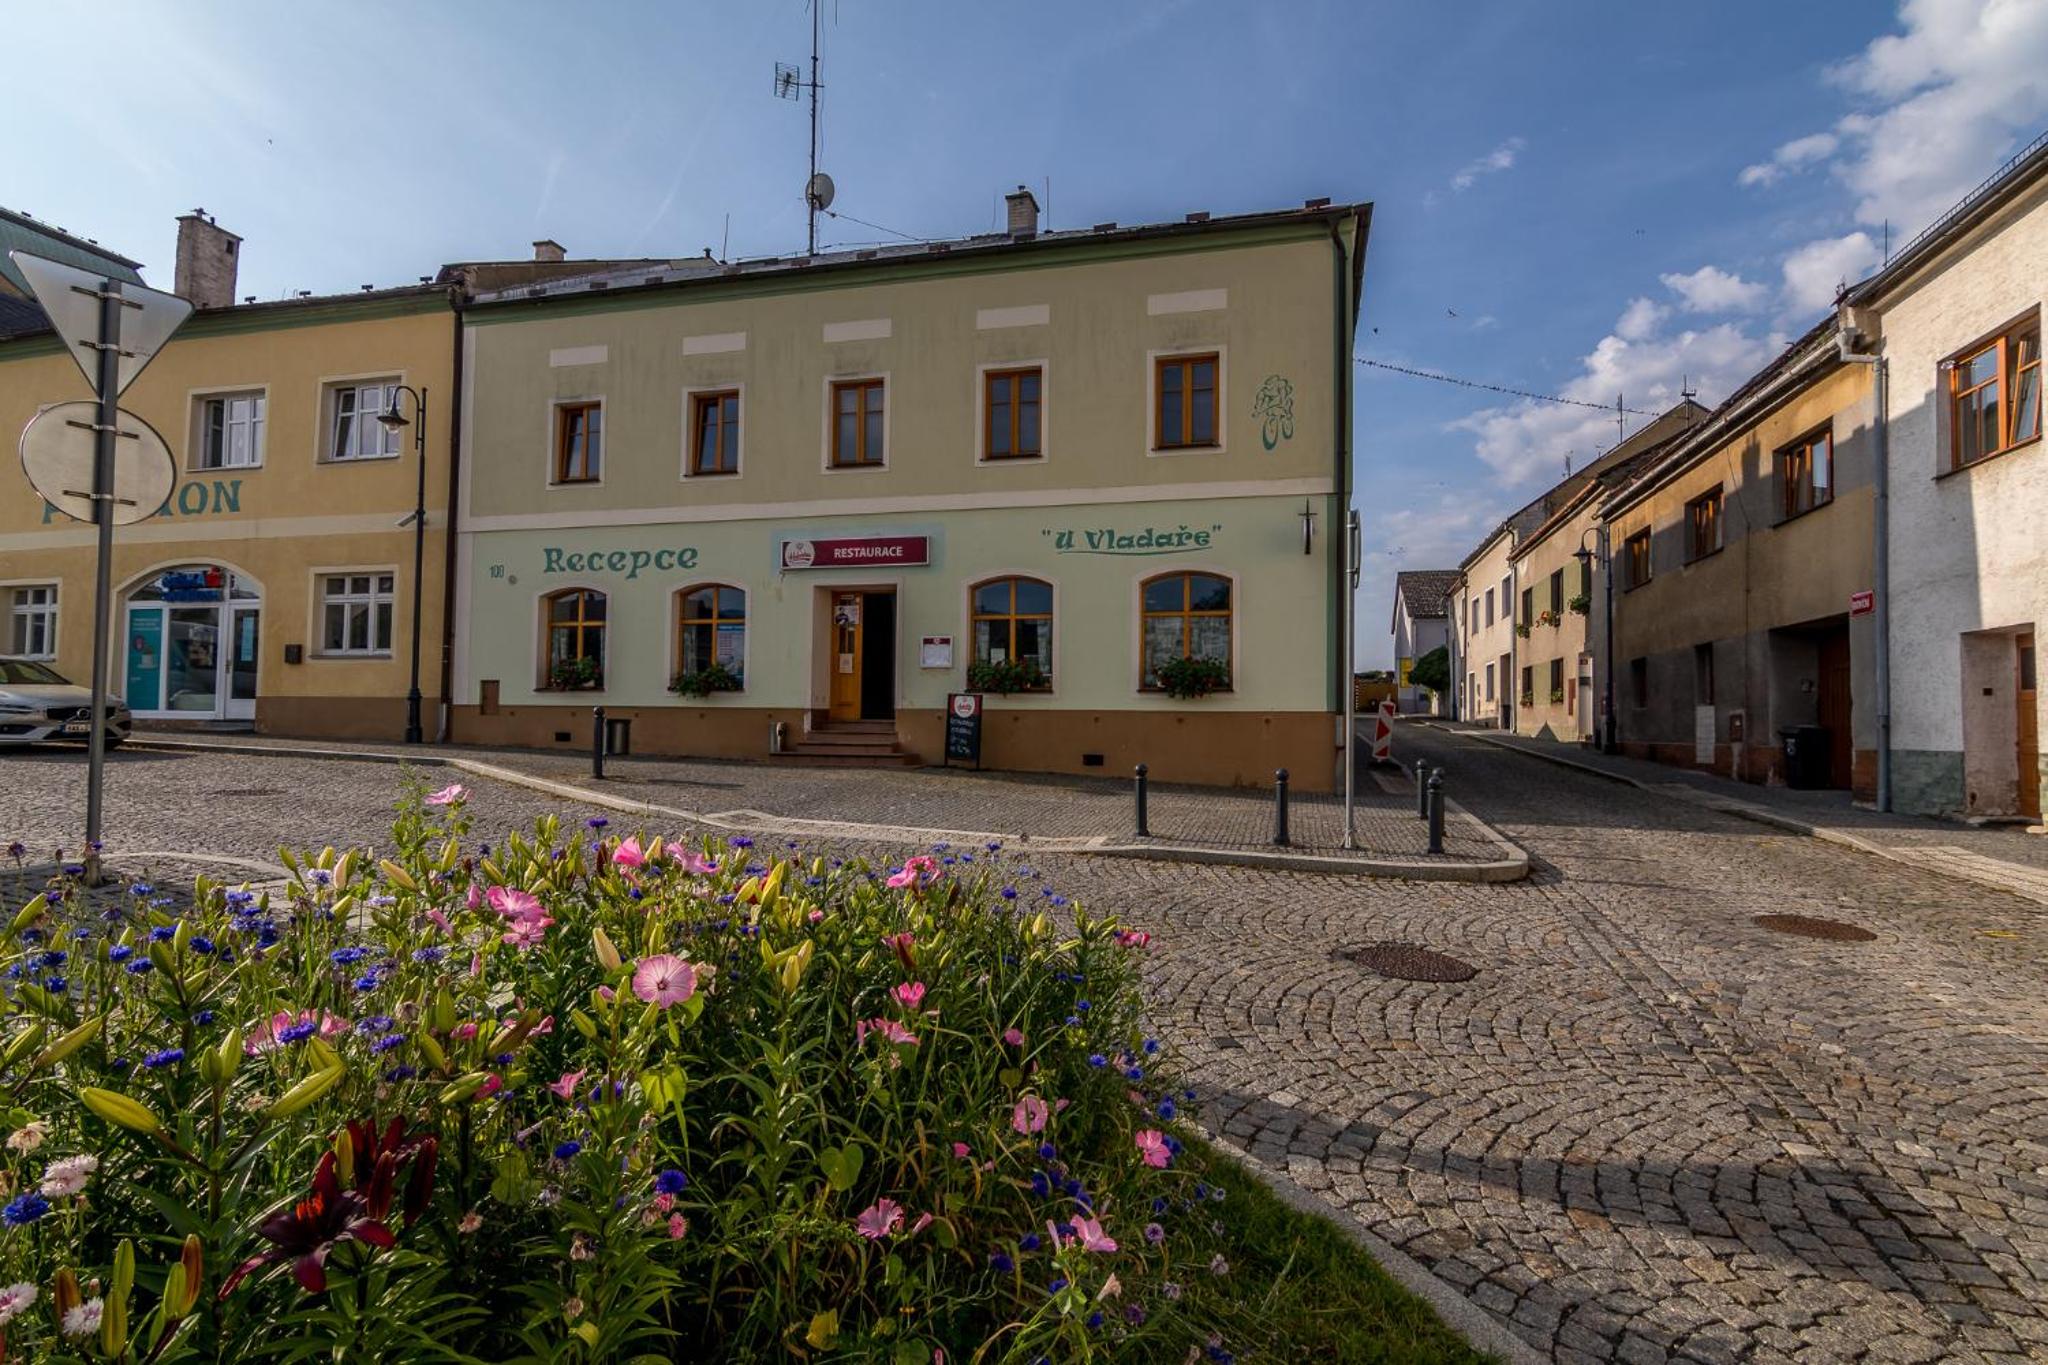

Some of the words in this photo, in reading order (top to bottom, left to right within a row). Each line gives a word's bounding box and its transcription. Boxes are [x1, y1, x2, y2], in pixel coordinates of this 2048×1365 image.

[1084, 524, 1222, 549] Vladaře"
[543, 546, 699, 580] Recepce
[833, 546, 904, 559] RESTAURACE
